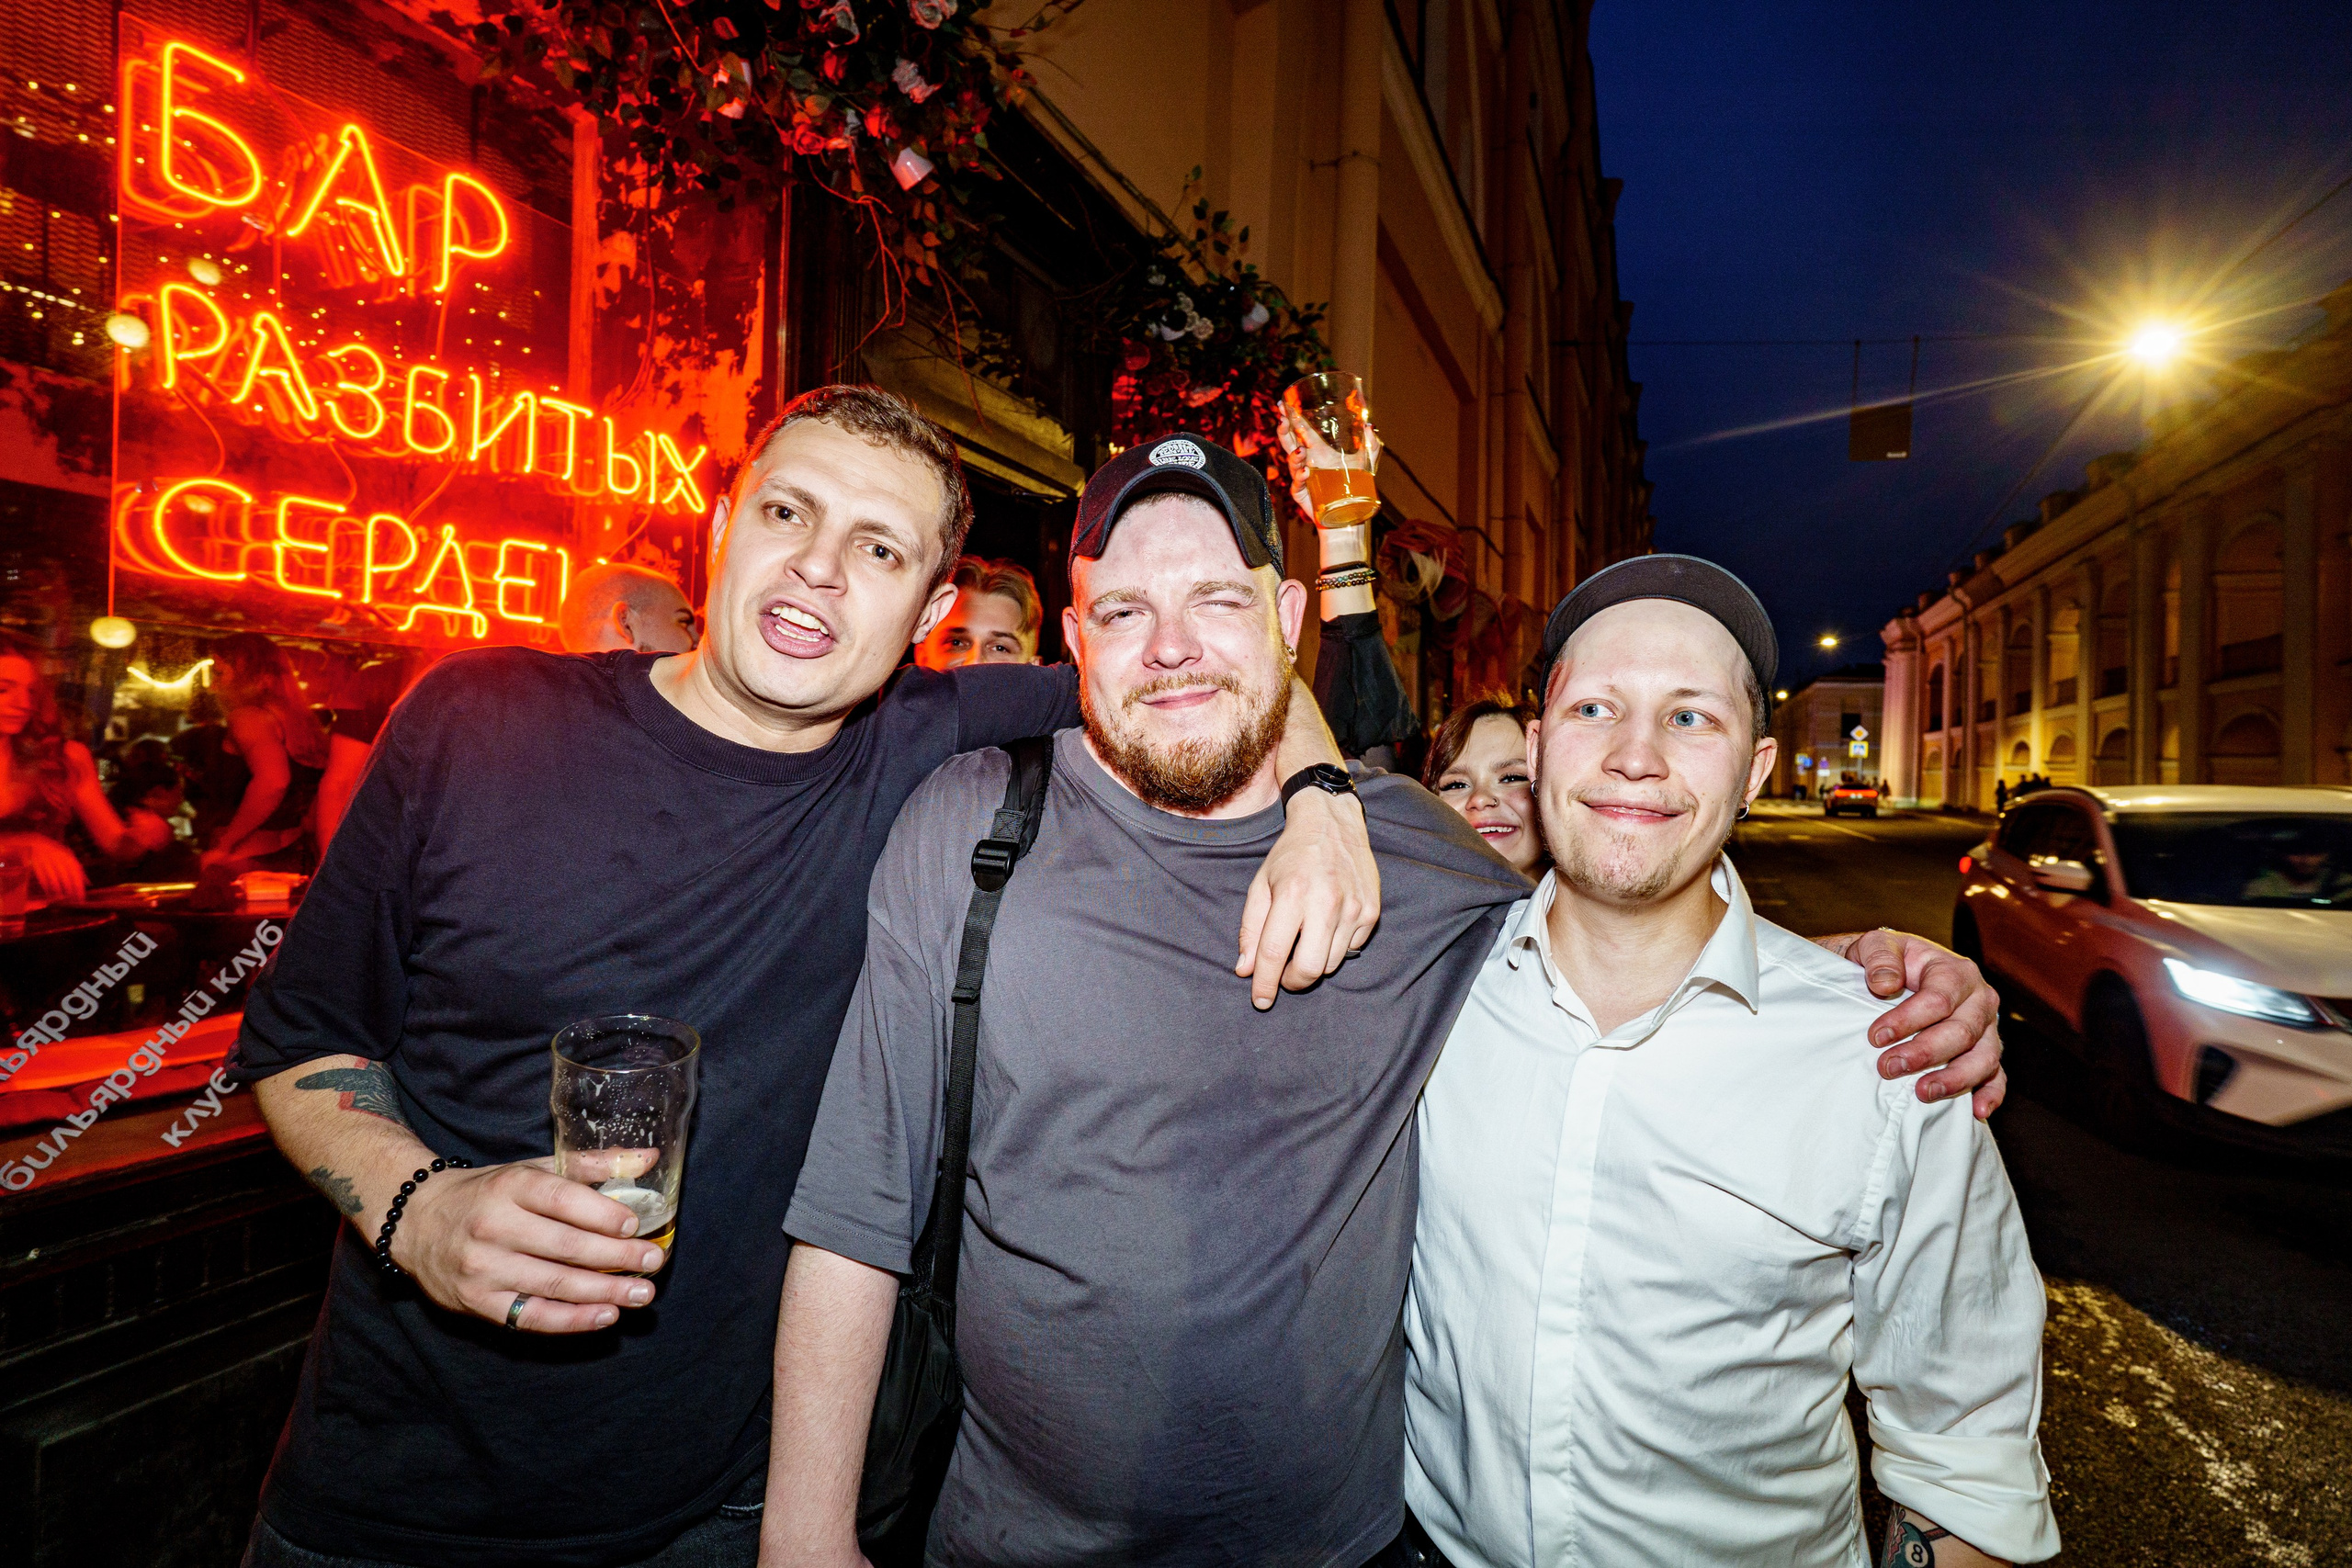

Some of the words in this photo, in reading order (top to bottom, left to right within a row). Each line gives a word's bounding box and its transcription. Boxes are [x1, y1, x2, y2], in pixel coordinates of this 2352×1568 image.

[162, 41, 509, 292] БАР
[159, 282, 708, 513] РАЗБИТЫХ
[0, 989, 217, 1190] бильярдный
[209, 919, 284, 994] клуб
[161, 1066, 239, 1148] клуб
[1911, 1544, 1923, 1562] 8
